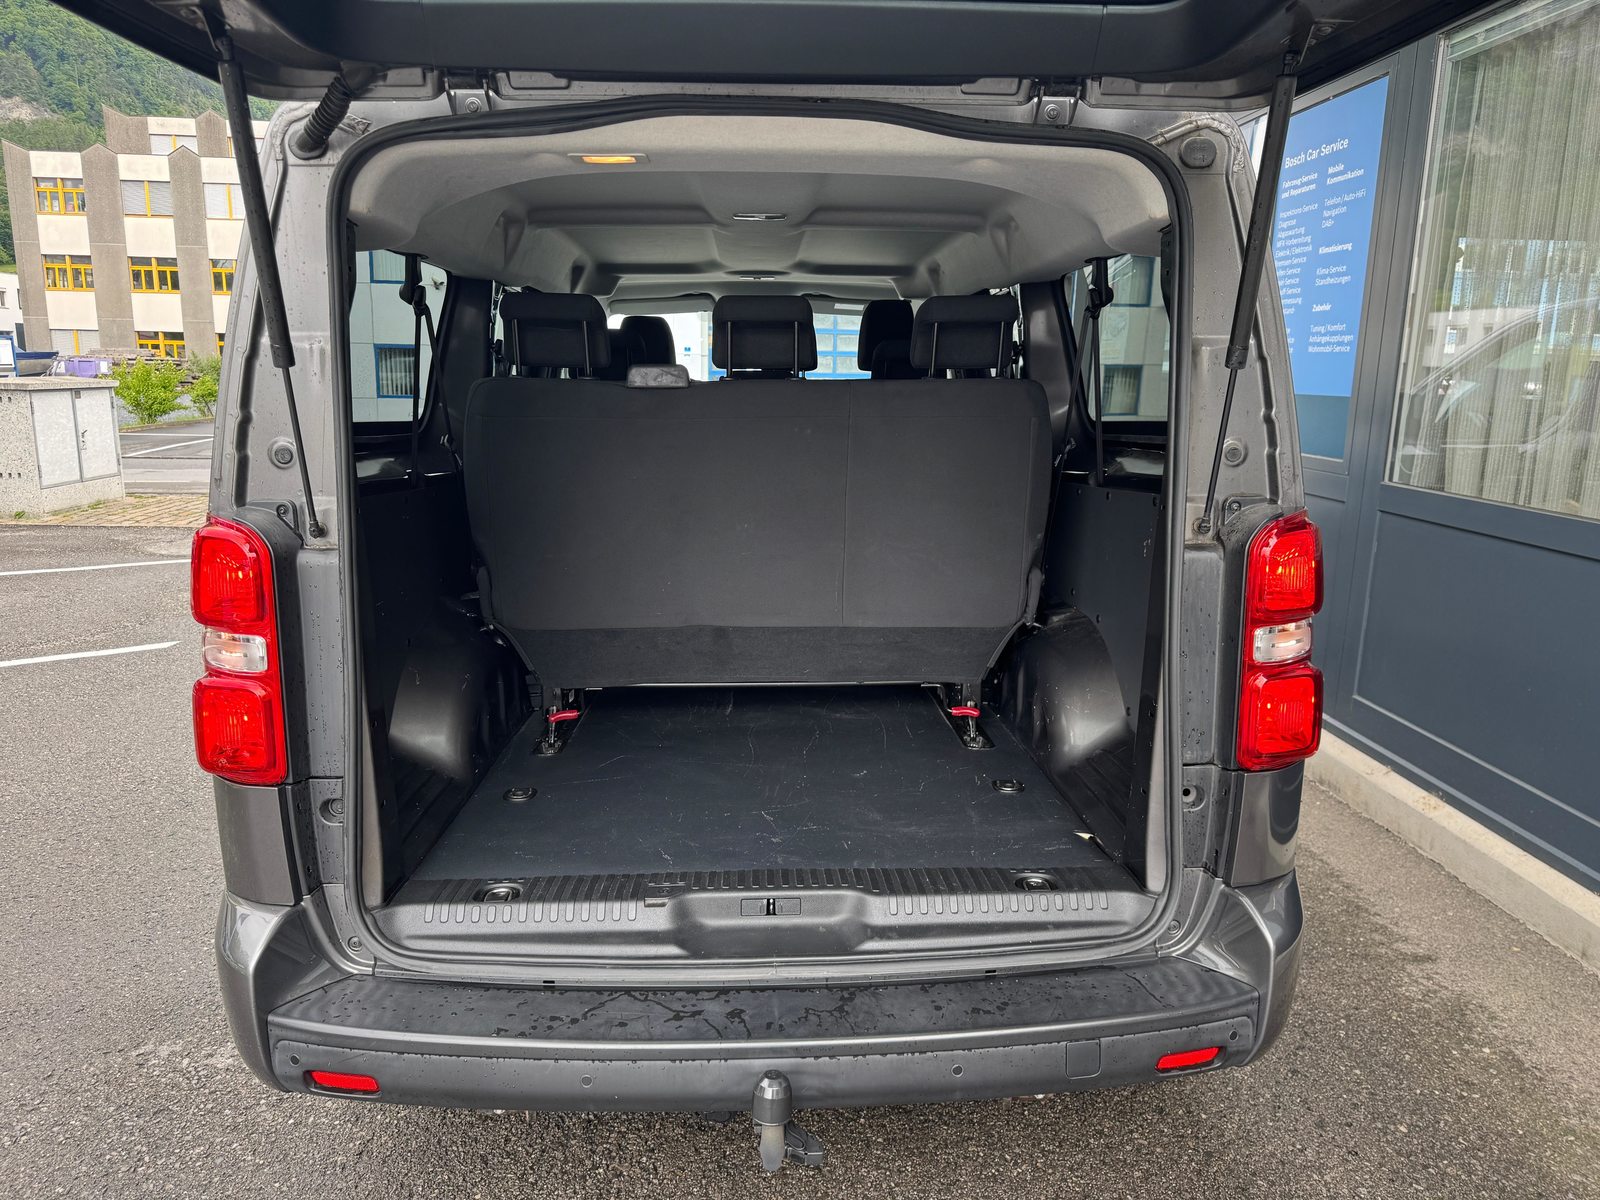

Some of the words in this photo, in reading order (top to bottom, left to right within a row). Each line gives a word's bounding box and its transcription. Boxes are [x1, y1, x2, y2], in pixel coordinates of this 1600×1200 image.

[1285, 152, 1305, 168] Bosch
[1306, 149, 1319, 160] Car
[1320, 138, 1349, 156] Service
[1328, 163, 1344, 174] Mobile
[1282, 172, 1318, 188] Fahrzeug-Service
[1327, 168, 1364, 185] Kommunikation
[1282, 190, 1290, 199] und
[1290, 184, 1316, 197] Reparaturen
[1325, 196, 1340, 206] Telefon
[1323, 206, 1347, 218] Navigation
[1319, 242, 1352, 254] Klimatisierung
[1316, 266, 1346, 275] Klima-Service
[1315, 276, 1351, 286] Standheizungen
[1310, 324, 1324, 334] Tuning
[1328, 322, 1346, 331] Komfort
[1308, 344, 1350, 352] Wohnmobil-Service
